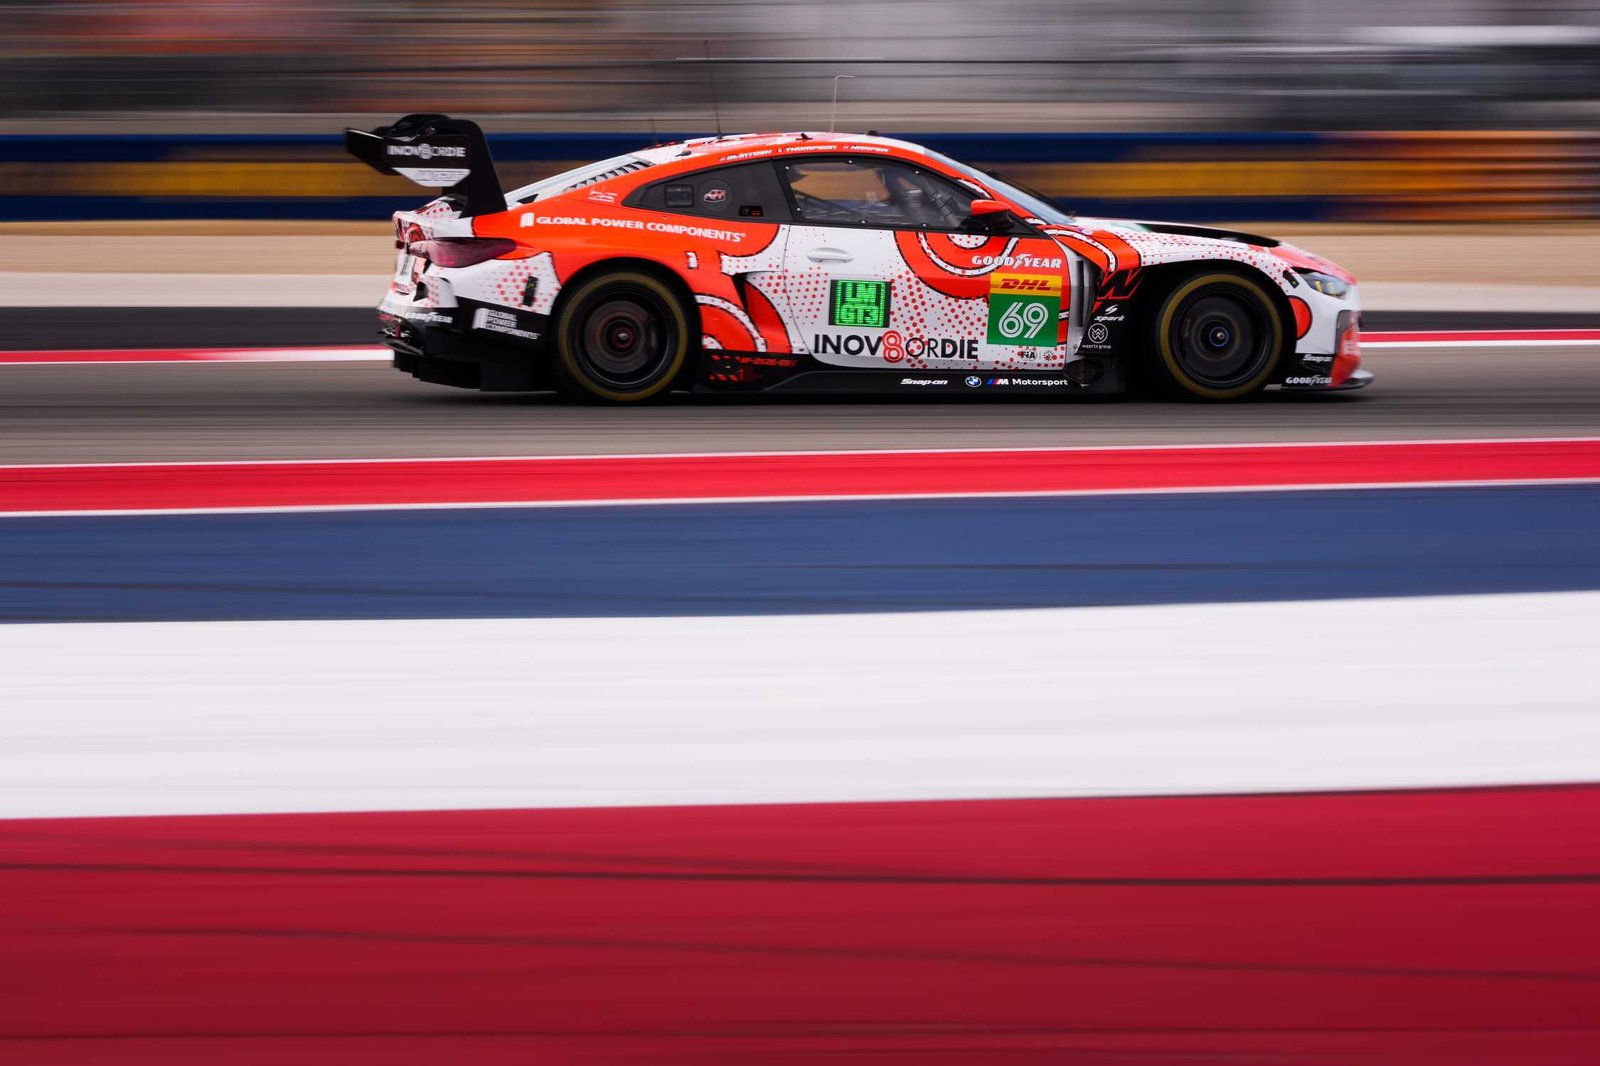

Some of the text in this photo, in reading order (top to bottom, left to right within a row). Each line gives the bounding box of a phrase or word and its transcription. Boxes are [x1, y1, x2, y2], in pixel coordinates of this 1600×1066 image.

[785, 145, 838, 153] THOMPSON
[536, 216, 742, 243] GLOBAL POWER COMPONENTS
[971, 253, 1062, 269] GOODYEAR
[1000, 278, 1052, 291] DHL
[487, 316, 518, 329] POWER
[488, 310, 517, 322] GLOBAL
[998, 301, 1049, 339] 69
[814, 330, 979, 364] INOV8ORDIE
[900, 378, 948, 386] Snap-on
[1012, 378, 1068, 387] Motorsport
